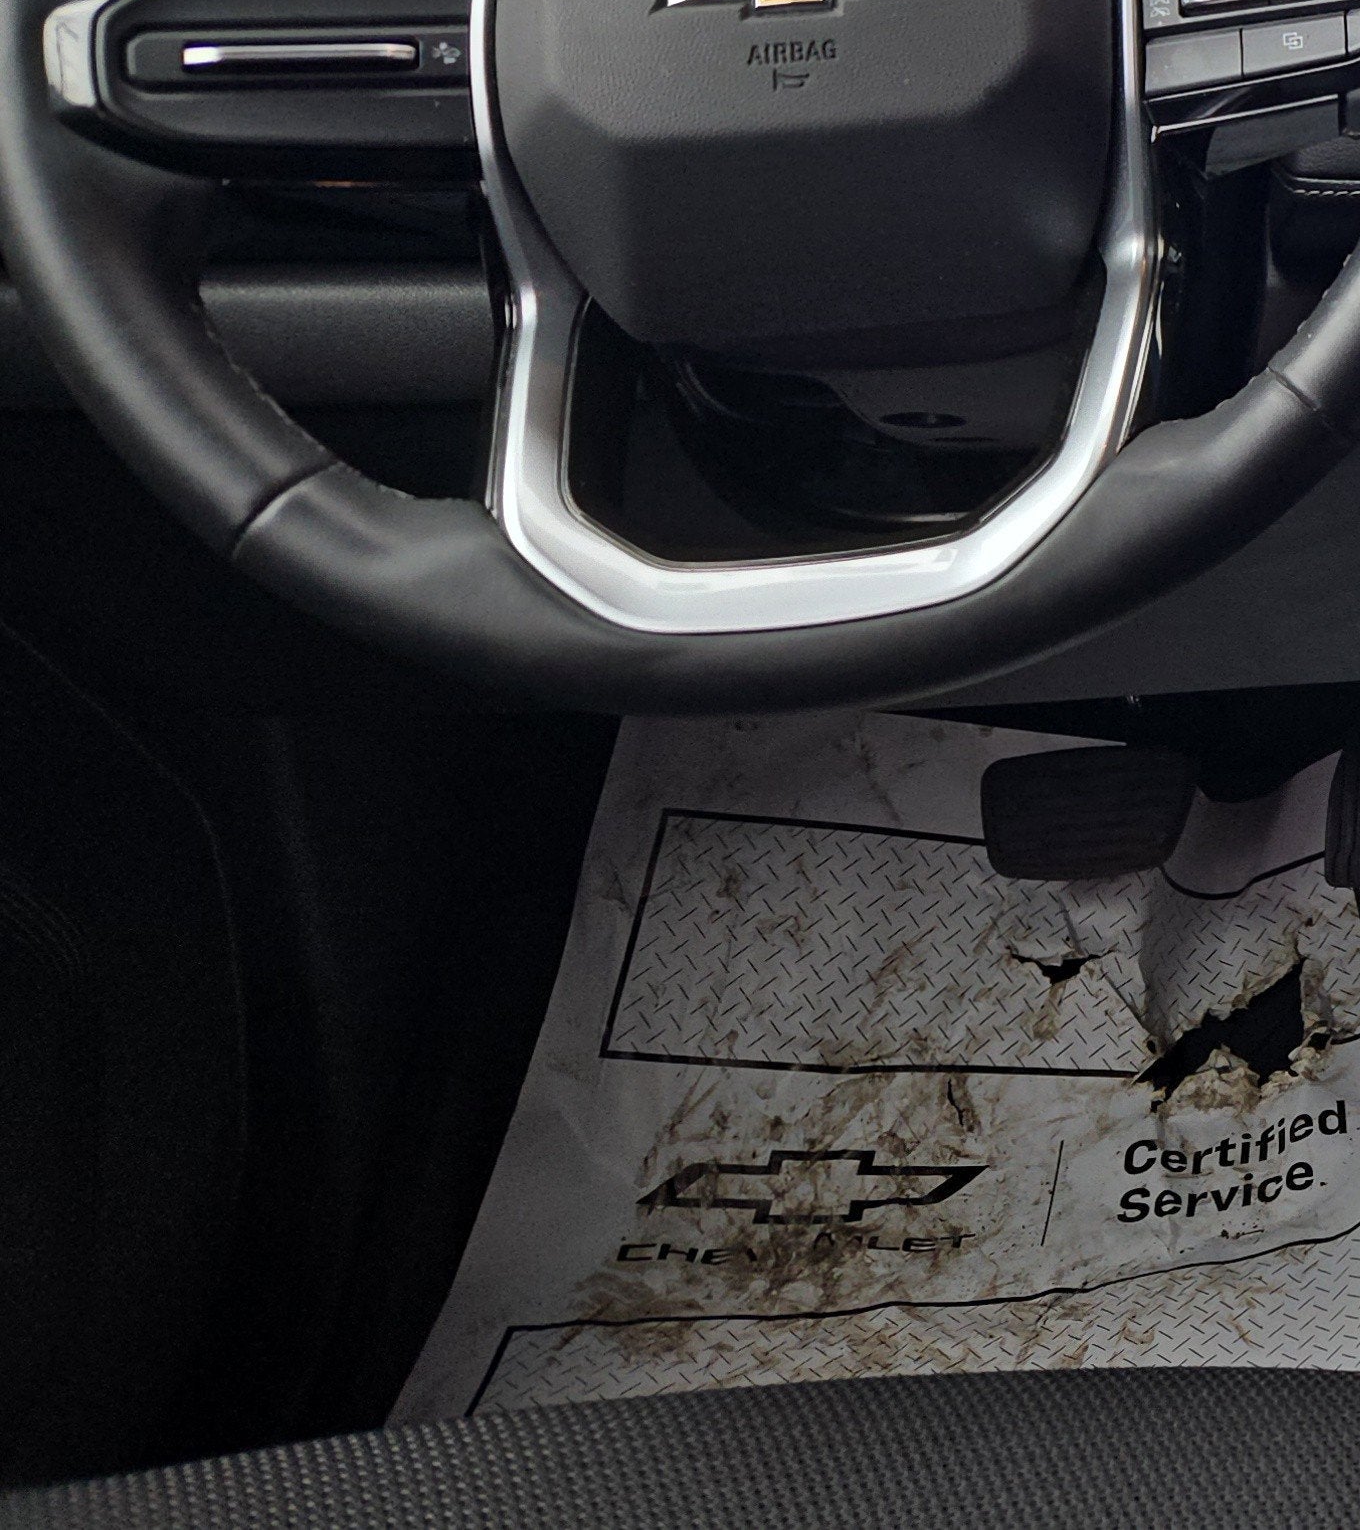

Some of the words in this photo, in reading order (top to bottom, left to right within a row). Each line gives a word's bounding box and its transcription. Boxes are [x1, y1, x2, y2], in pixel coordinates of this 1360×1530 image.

[746, 38, 837, 66] AIRBAG
[1123, 1099, 1348, 1175] Certified
[616, 1232, 976, 1265] CHELET
